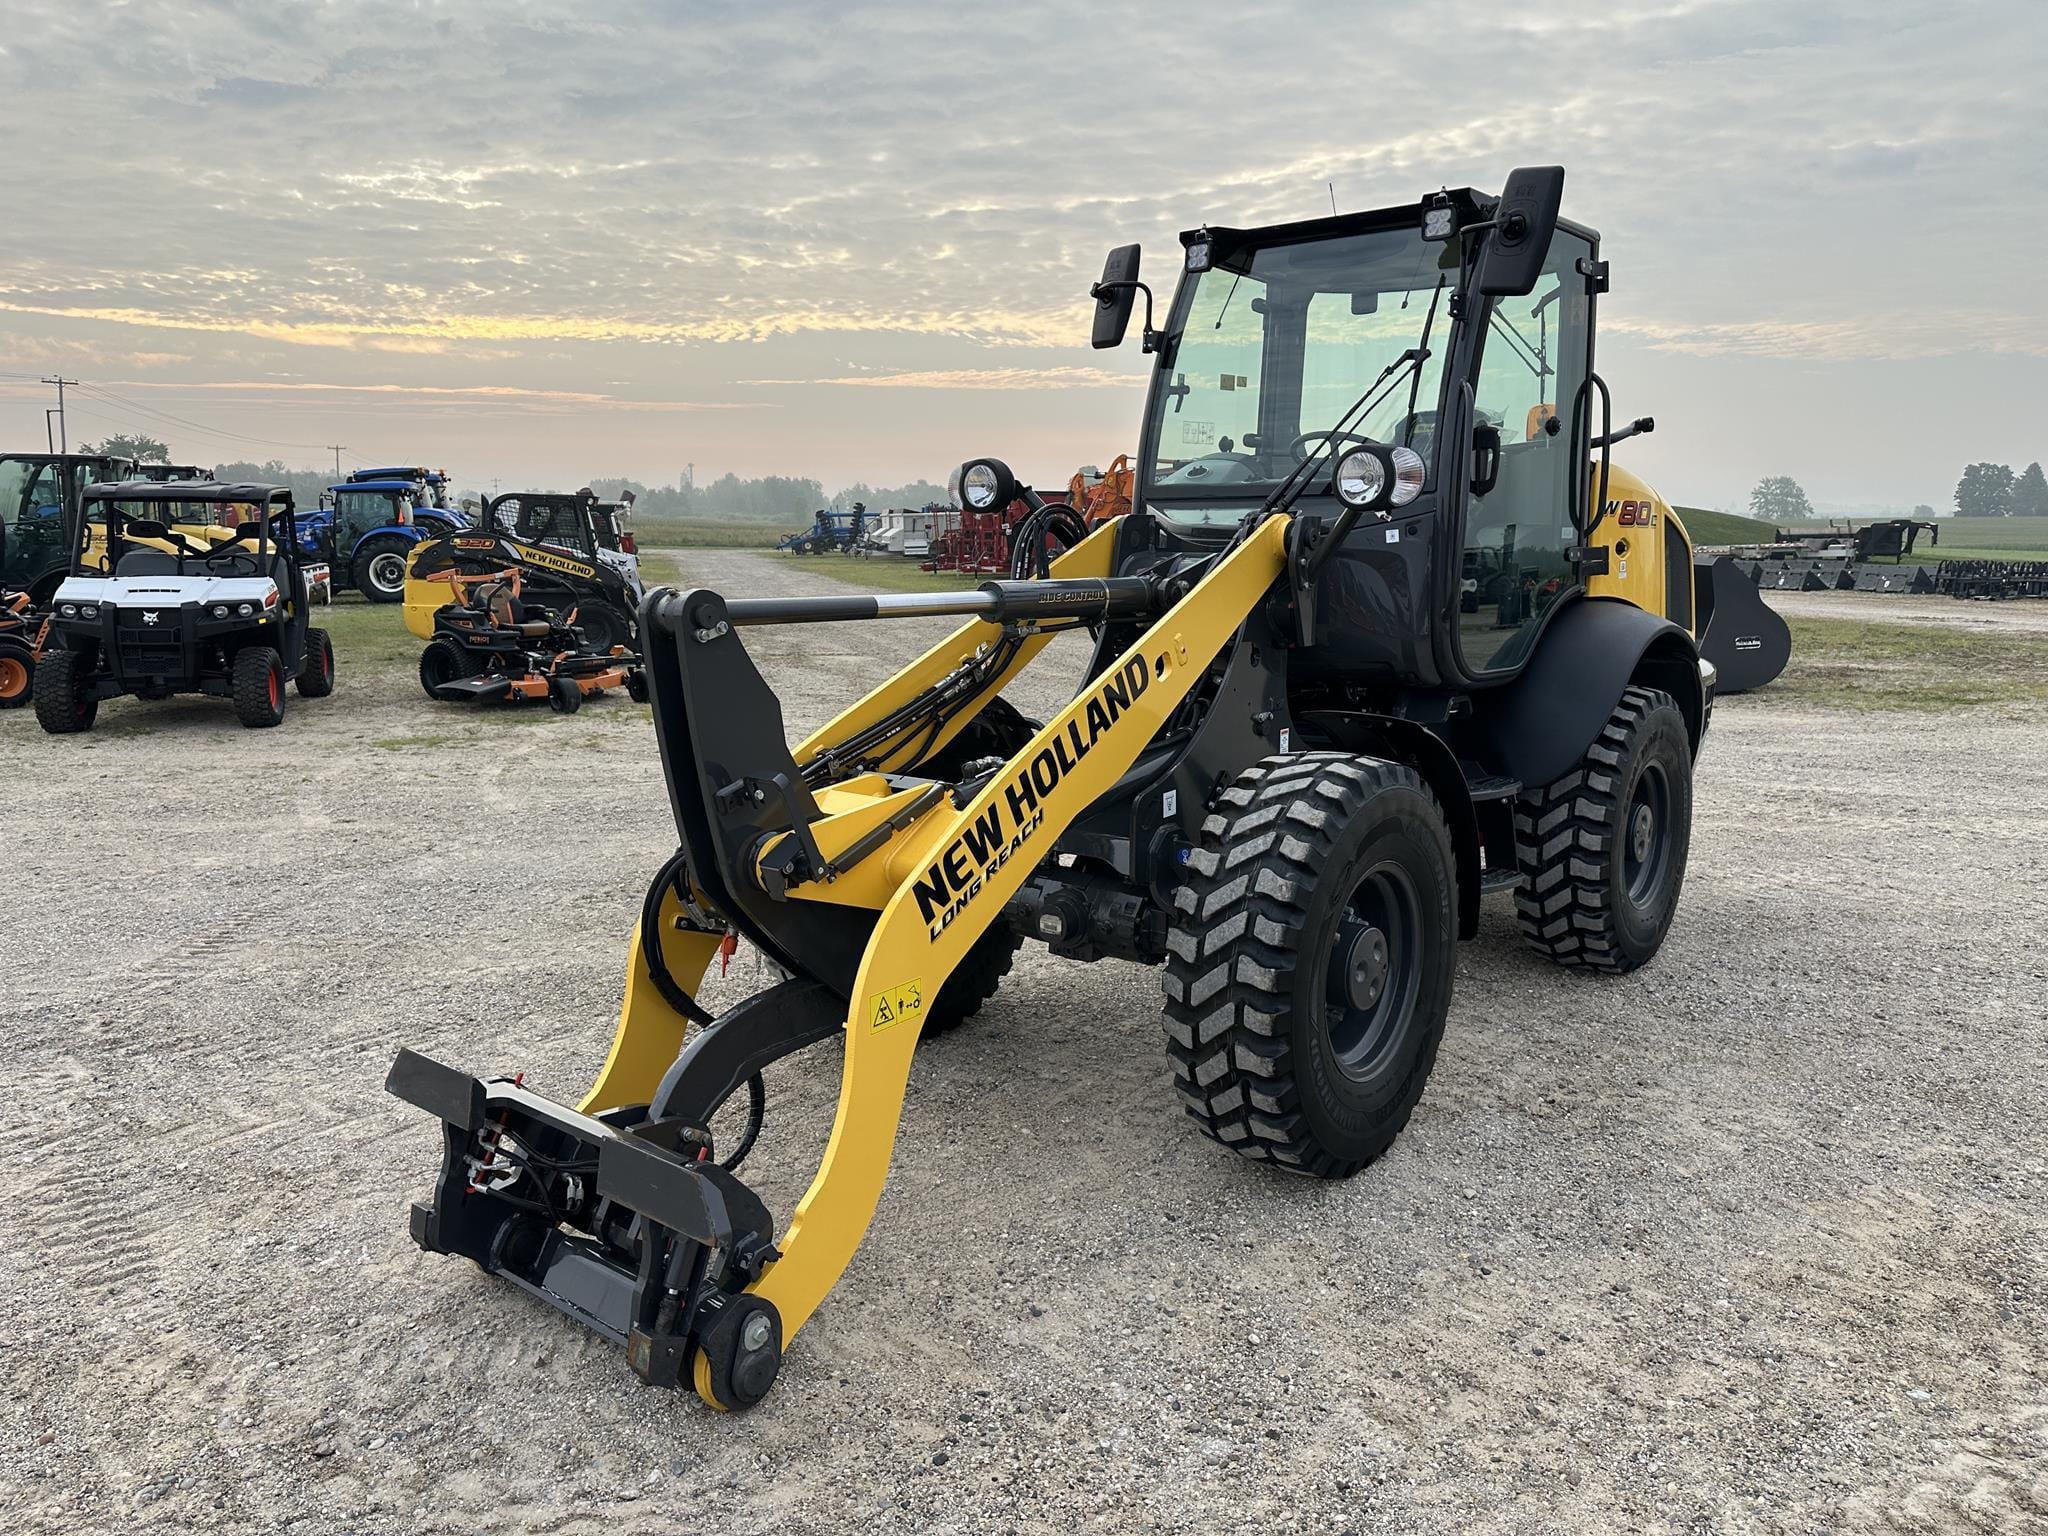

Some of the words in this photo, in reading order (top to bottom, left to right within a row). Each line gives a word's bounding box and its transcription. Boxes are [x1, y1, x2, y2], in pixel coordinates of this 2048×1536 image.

[525, 550, 548, 564] NEW
[549, 555, 591, 576] HOLLAND
[1038, 592, 1062, 604] RIDE
[1063, 590, 1106, 602] CONTROL
[911, 803, 1004, 926] NEW
[1004, 652, 1150, 825] HOLLAND
[928, 883, 981, 944] LONG
[985, 807, 1045, 879] REACH
